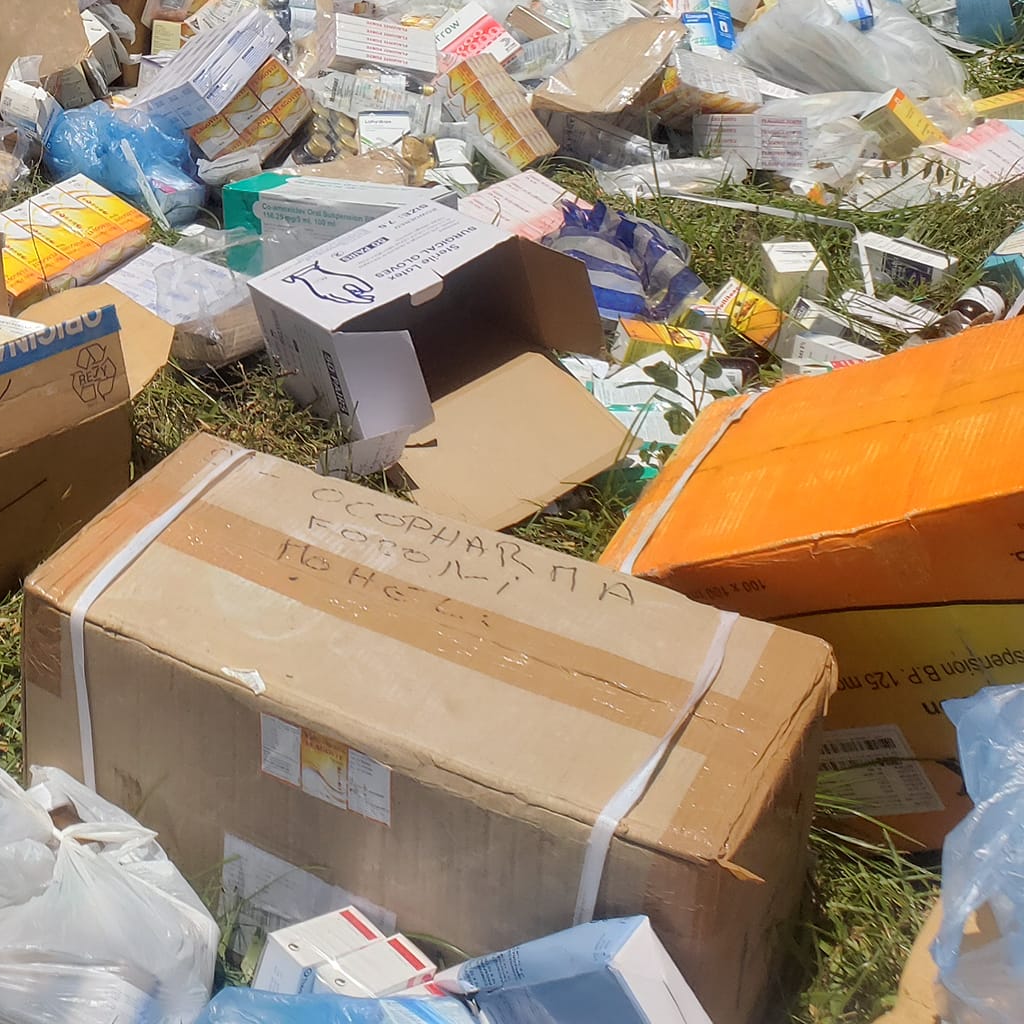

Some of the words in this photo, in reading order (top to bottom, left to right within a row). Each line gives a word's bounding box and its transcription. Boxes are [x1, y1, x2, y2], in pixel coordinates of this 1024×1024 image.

[419, 224, 478, 255] SURGICAL
[421, 243, 461, 264] Sterile
[374, 253, 422, 279] GLOVES
[388, 261, 423, 282] Latex
[311, 487, 636, 608] OCOPHARMA
[864, 670, 899, 691] 125
[899, 663, 943, 686] B.P.
